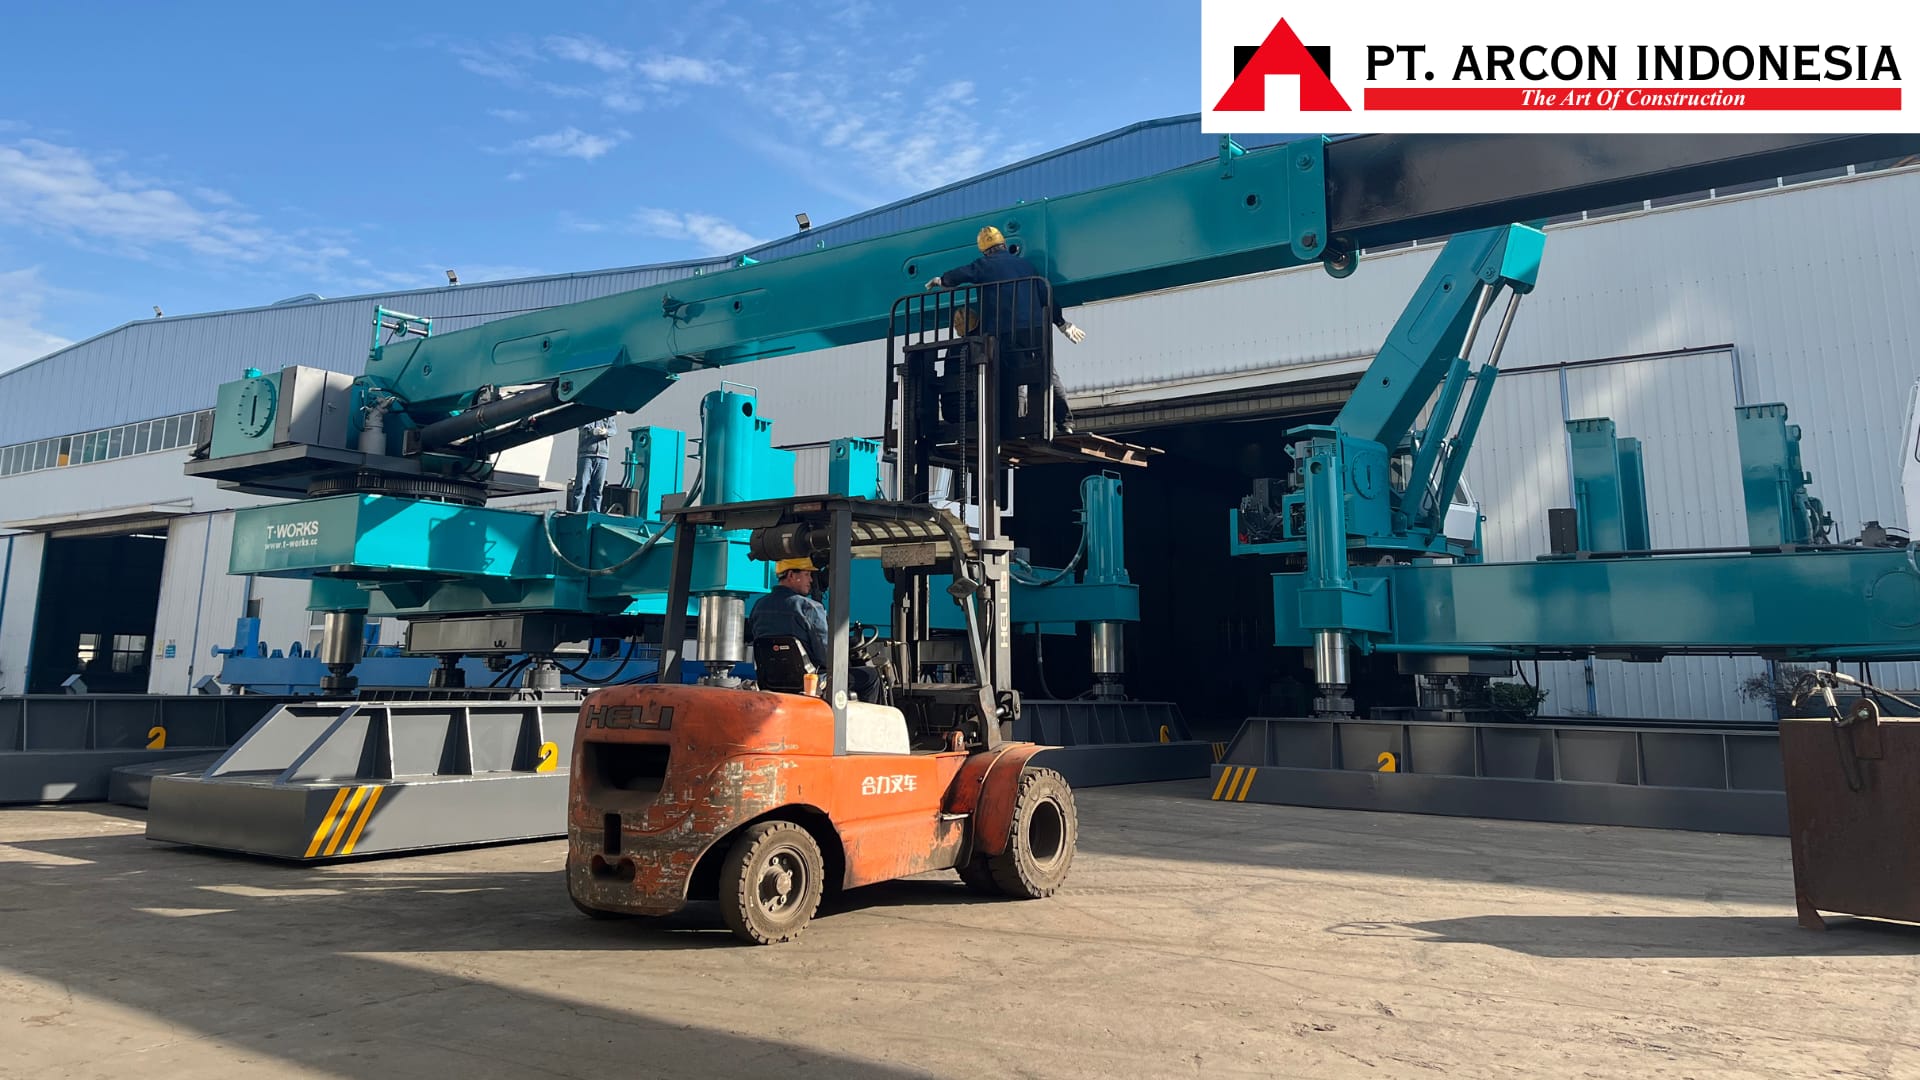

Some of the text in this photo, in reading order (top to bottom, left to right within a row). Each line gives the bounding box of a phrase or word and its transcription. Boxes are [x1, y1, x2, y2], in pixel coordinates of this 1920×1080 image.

[585, 704, 674, 731] HELI
[861, 774, 917, 796] 合力叉车
